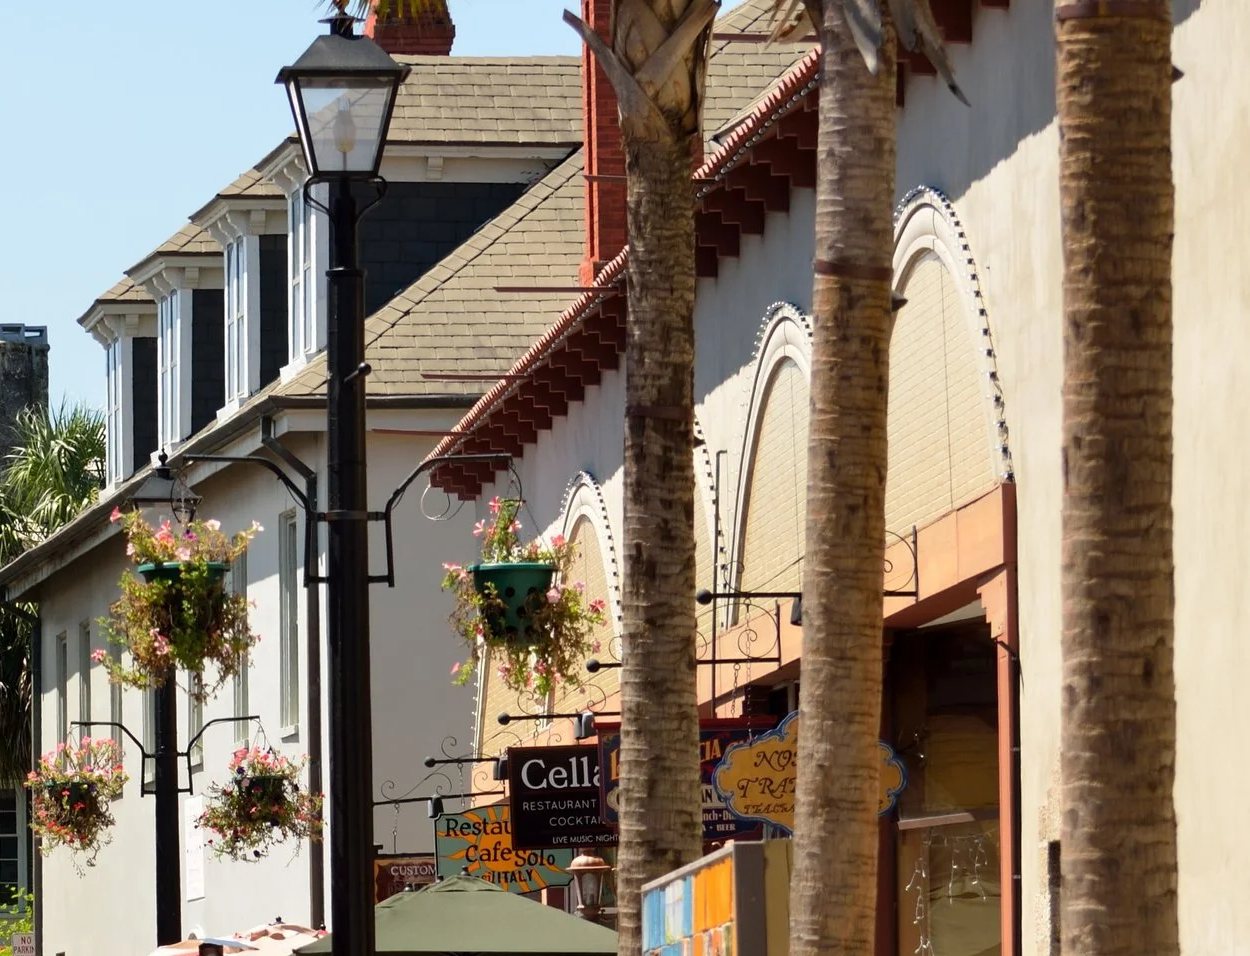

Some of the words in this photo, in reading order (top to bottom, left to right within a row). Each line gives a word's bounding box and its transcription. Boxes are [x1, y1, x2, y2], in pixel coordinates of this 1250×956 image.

[522, 799, 597, 811] RESTAURANT
[549, 816, 602, 827] COCKTAI
[552, 836, 568, 844] LIVE
[570, 835, 594, 843] MUSIC
[596, 834, 620, 842] NIGHT
[465, 842, 511, 863] Cafe
[514, 849, 556, 867] Solo
[497, 867, 534, 884] ITALY
[21, 936, 32, 944] NO
[14, 946, 34, 954] PARKIN
